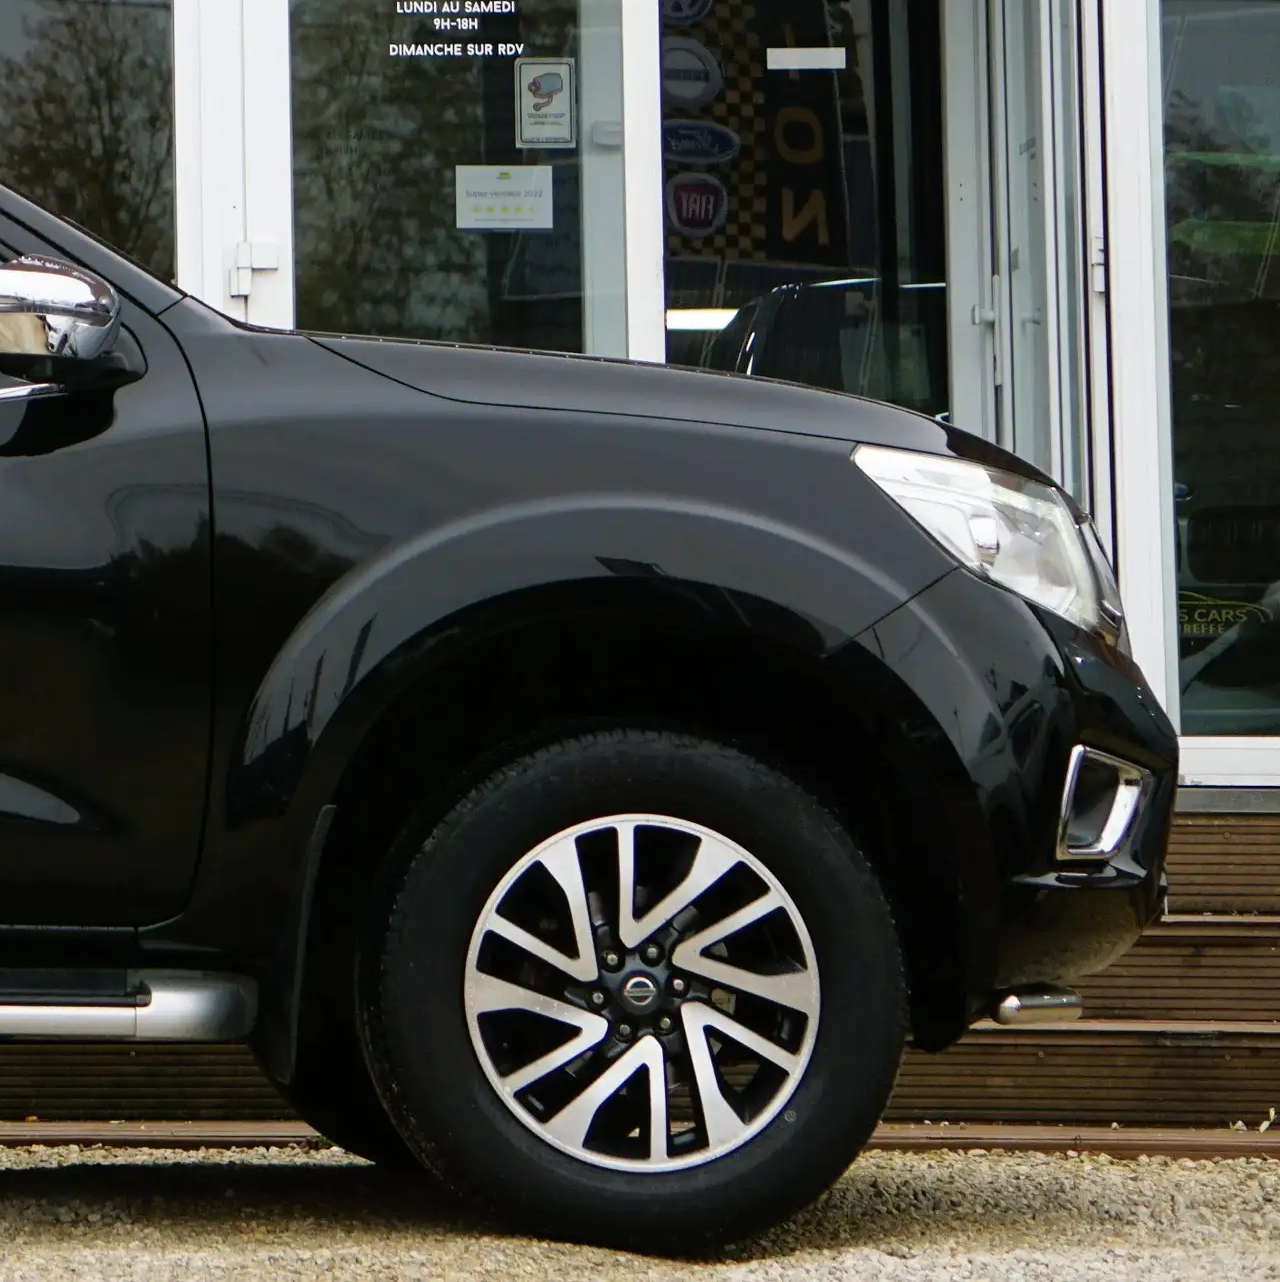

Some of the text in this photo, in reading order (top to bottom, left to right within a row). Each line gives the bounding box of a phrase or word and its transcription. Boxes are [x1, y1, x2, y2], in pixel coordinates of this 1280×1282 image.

[396, 0, 515, 13] LUNDI AU SAMEDI
[433, 17, 478, 30] 9H-18H
[389, 43, 524, 56] DIMANCHE SUR RDV
[1194, 609, 1248, 622] CARS
